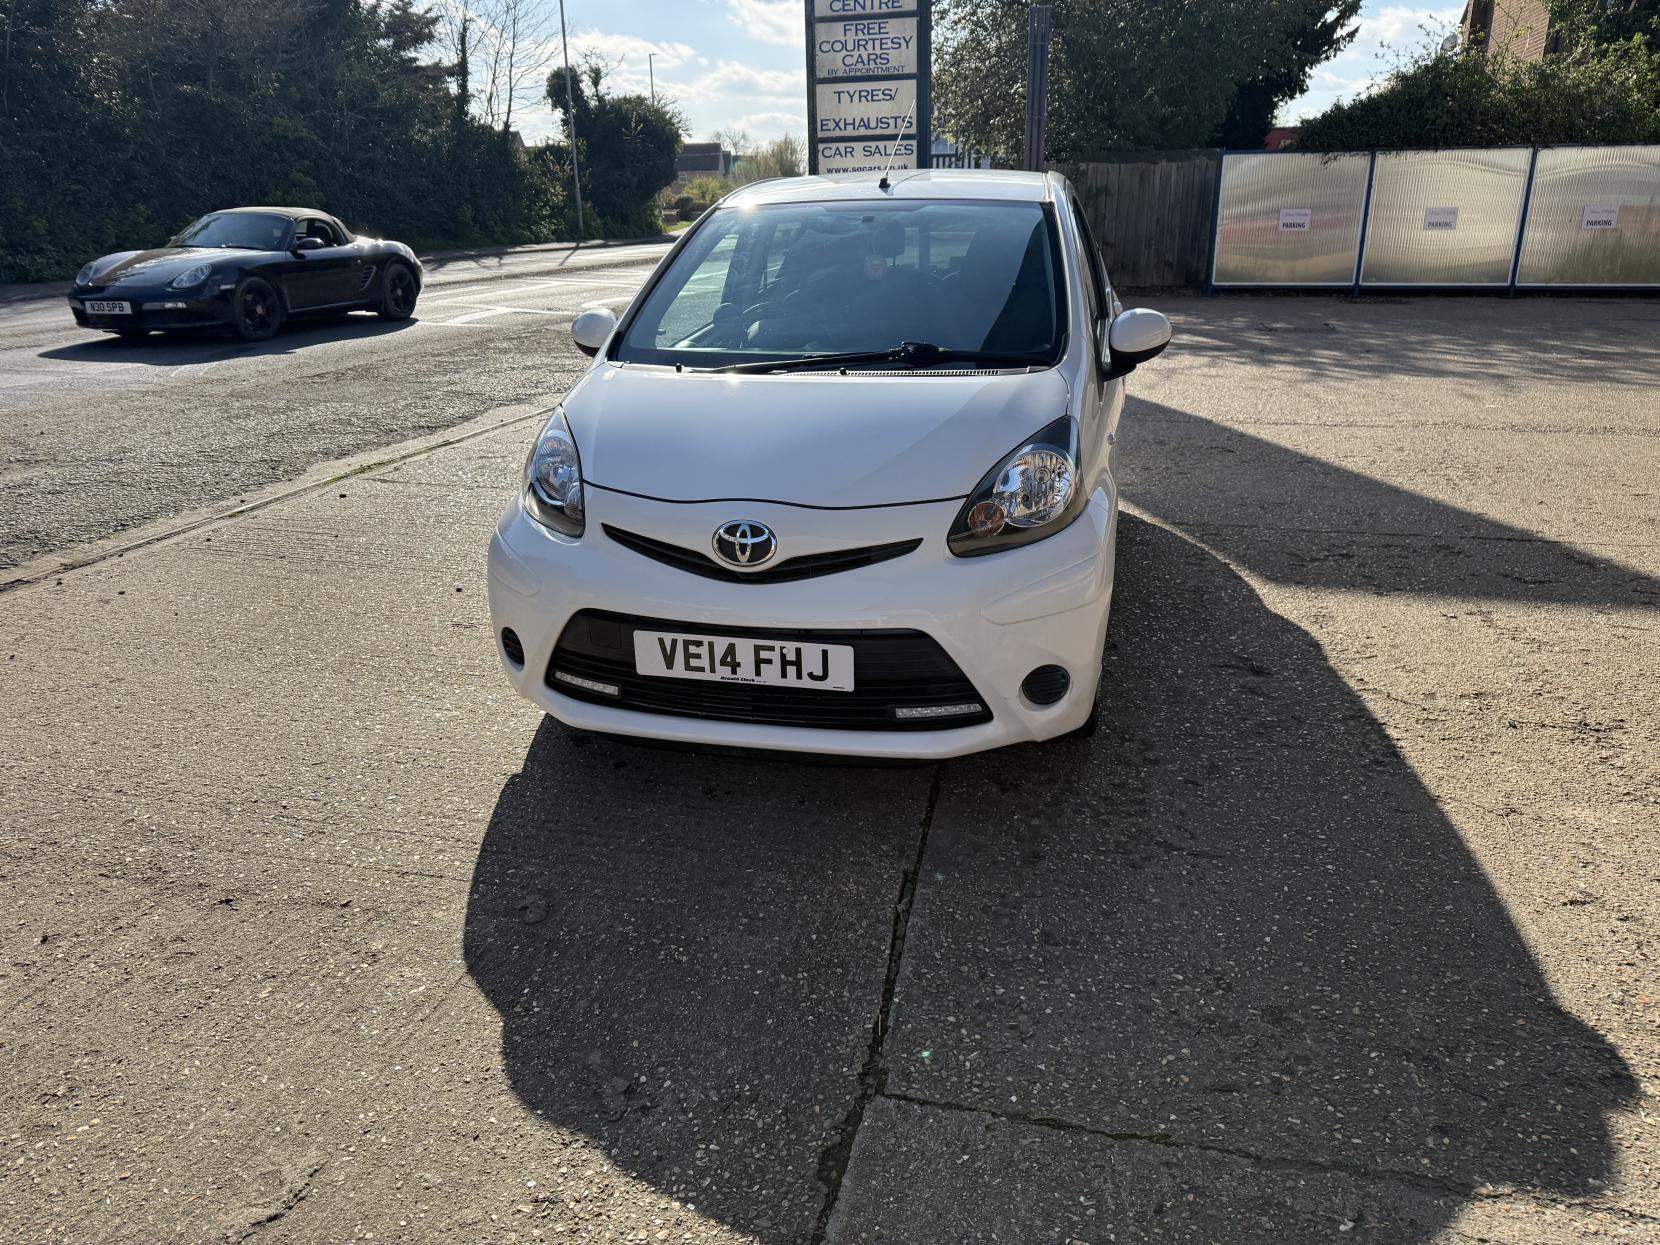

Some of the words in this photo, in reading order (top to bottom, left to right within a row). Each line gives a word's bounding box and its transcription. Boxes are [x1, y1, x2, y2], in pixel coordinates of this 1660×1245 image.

[830, 0, 902, 12] CENTRE
[843, 21, 889, 37] FREE
[818, 36, 913, 54] COURTESY
[842, 53, 890, 67] CARS
[827, 68, 838, 76] BY
[842, 65, 906, 76] APPOINTMENT
[834, 88, 898, 104] TYRES/
[820, 115, 913, 132] EXHAUSTS
[821, 146, 855, 159] CAR
[862, 143, 914, 157] SALES
[1586, 219, 1612, 227] PARKING
[106, 302, 124, 312] SPB
[657, 637, 742, 676] VE14
[753, 644, 830, 682] FHJ
